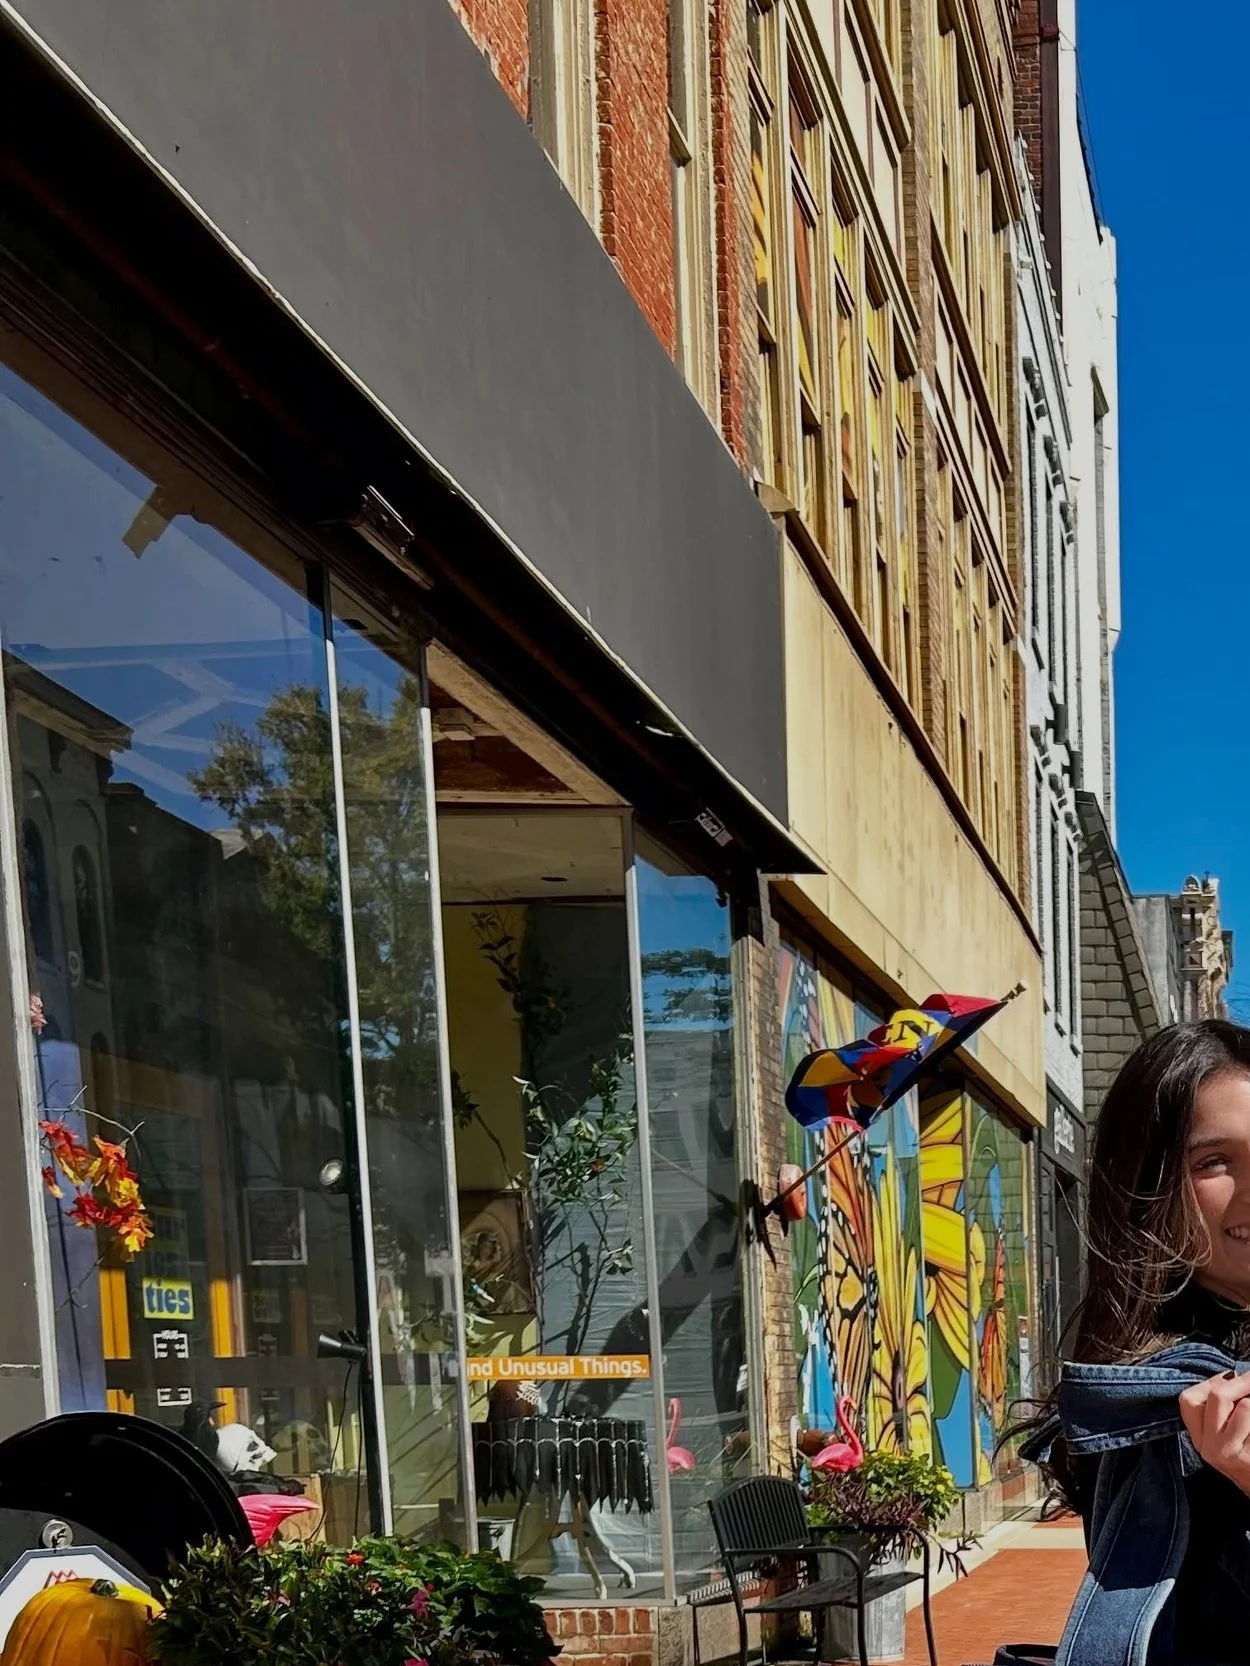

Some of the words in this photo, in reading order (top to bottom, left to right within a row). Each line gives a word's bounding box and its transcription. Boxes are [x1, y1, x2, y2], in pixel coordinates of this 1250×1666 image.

[145, 1279, 191, 1315] ties
[467, 1359, 493, 1377] nd
[499, 1358, 574, 1376] Unusual
[580, 1356, 648, 1378] Things.
